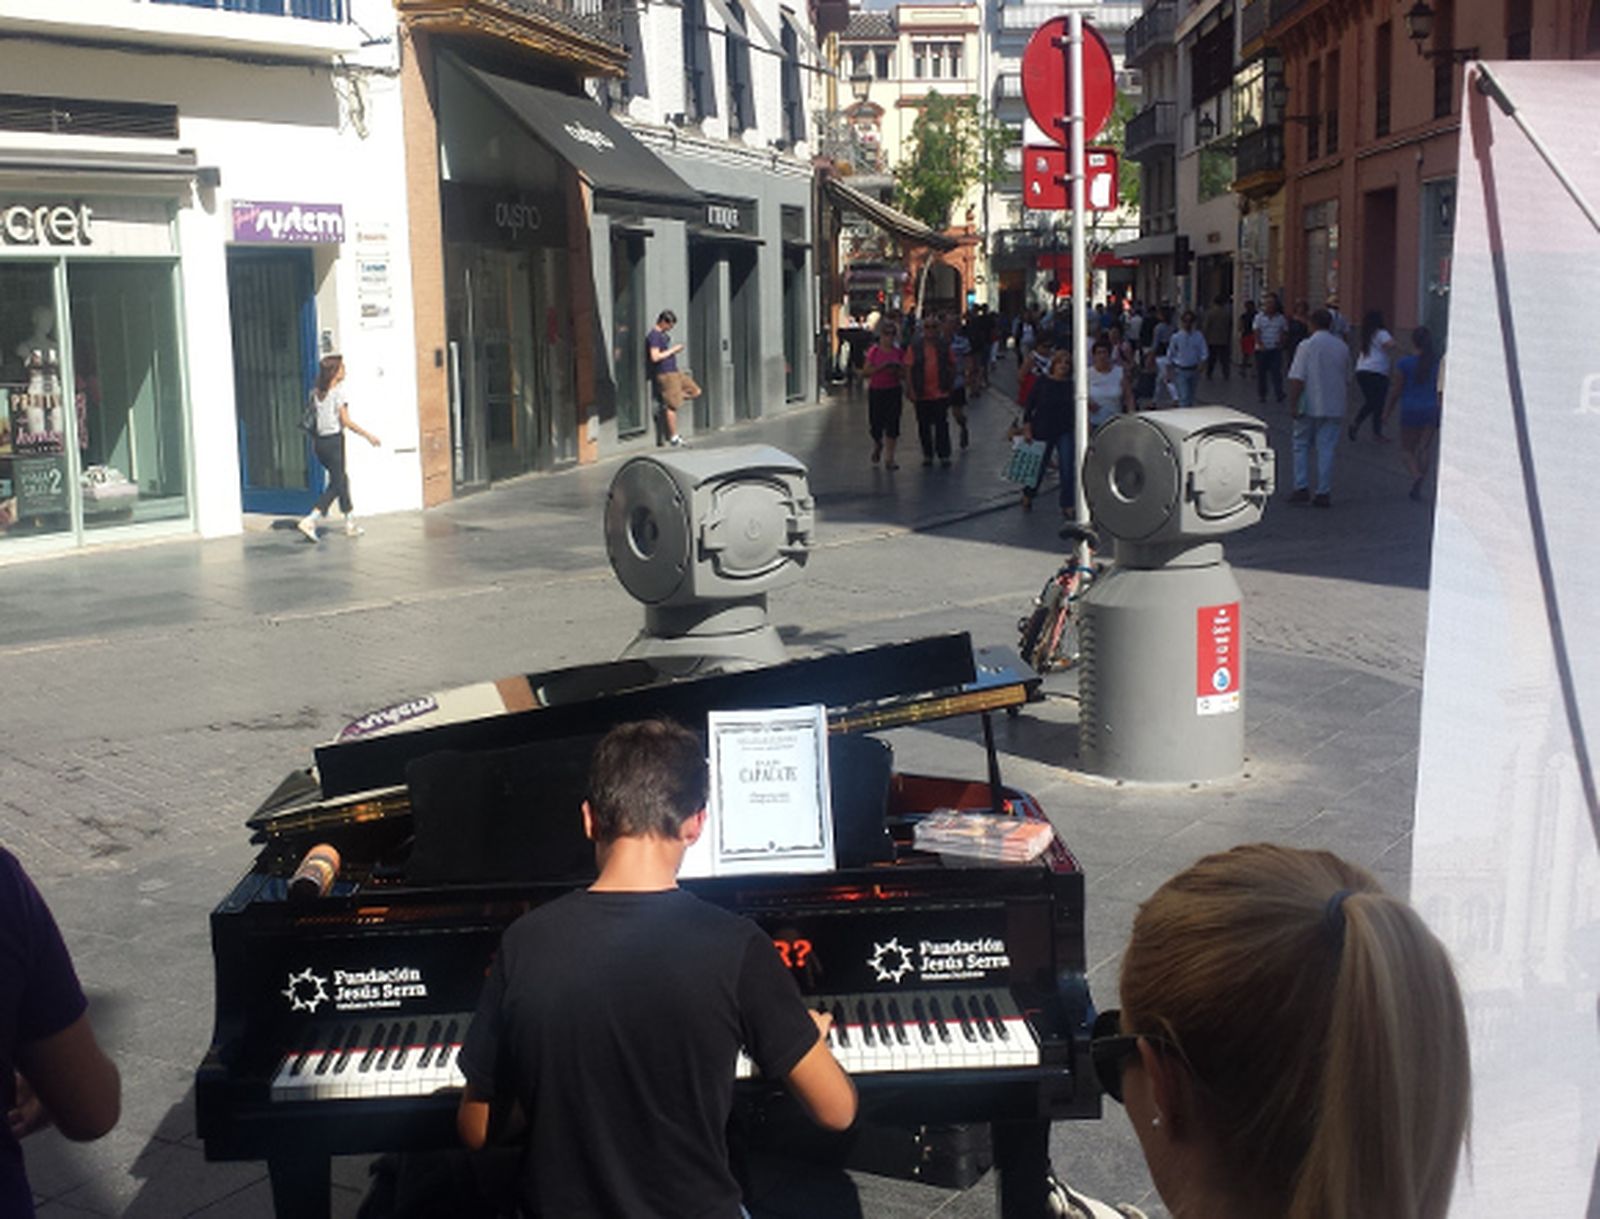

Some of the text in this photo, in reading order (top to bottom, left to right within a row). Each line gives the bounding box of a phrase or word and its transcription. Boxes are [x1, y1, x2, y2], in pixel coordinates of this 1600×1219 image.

[256, 206, 342, 238] system
[920, 938, 1005, 956] Fundación
[920, 954, 1010, 972] Jesús Serra
[333, 967, 421, 986] Fundación
[334, 983, 428, 1001] Jesús Serra
